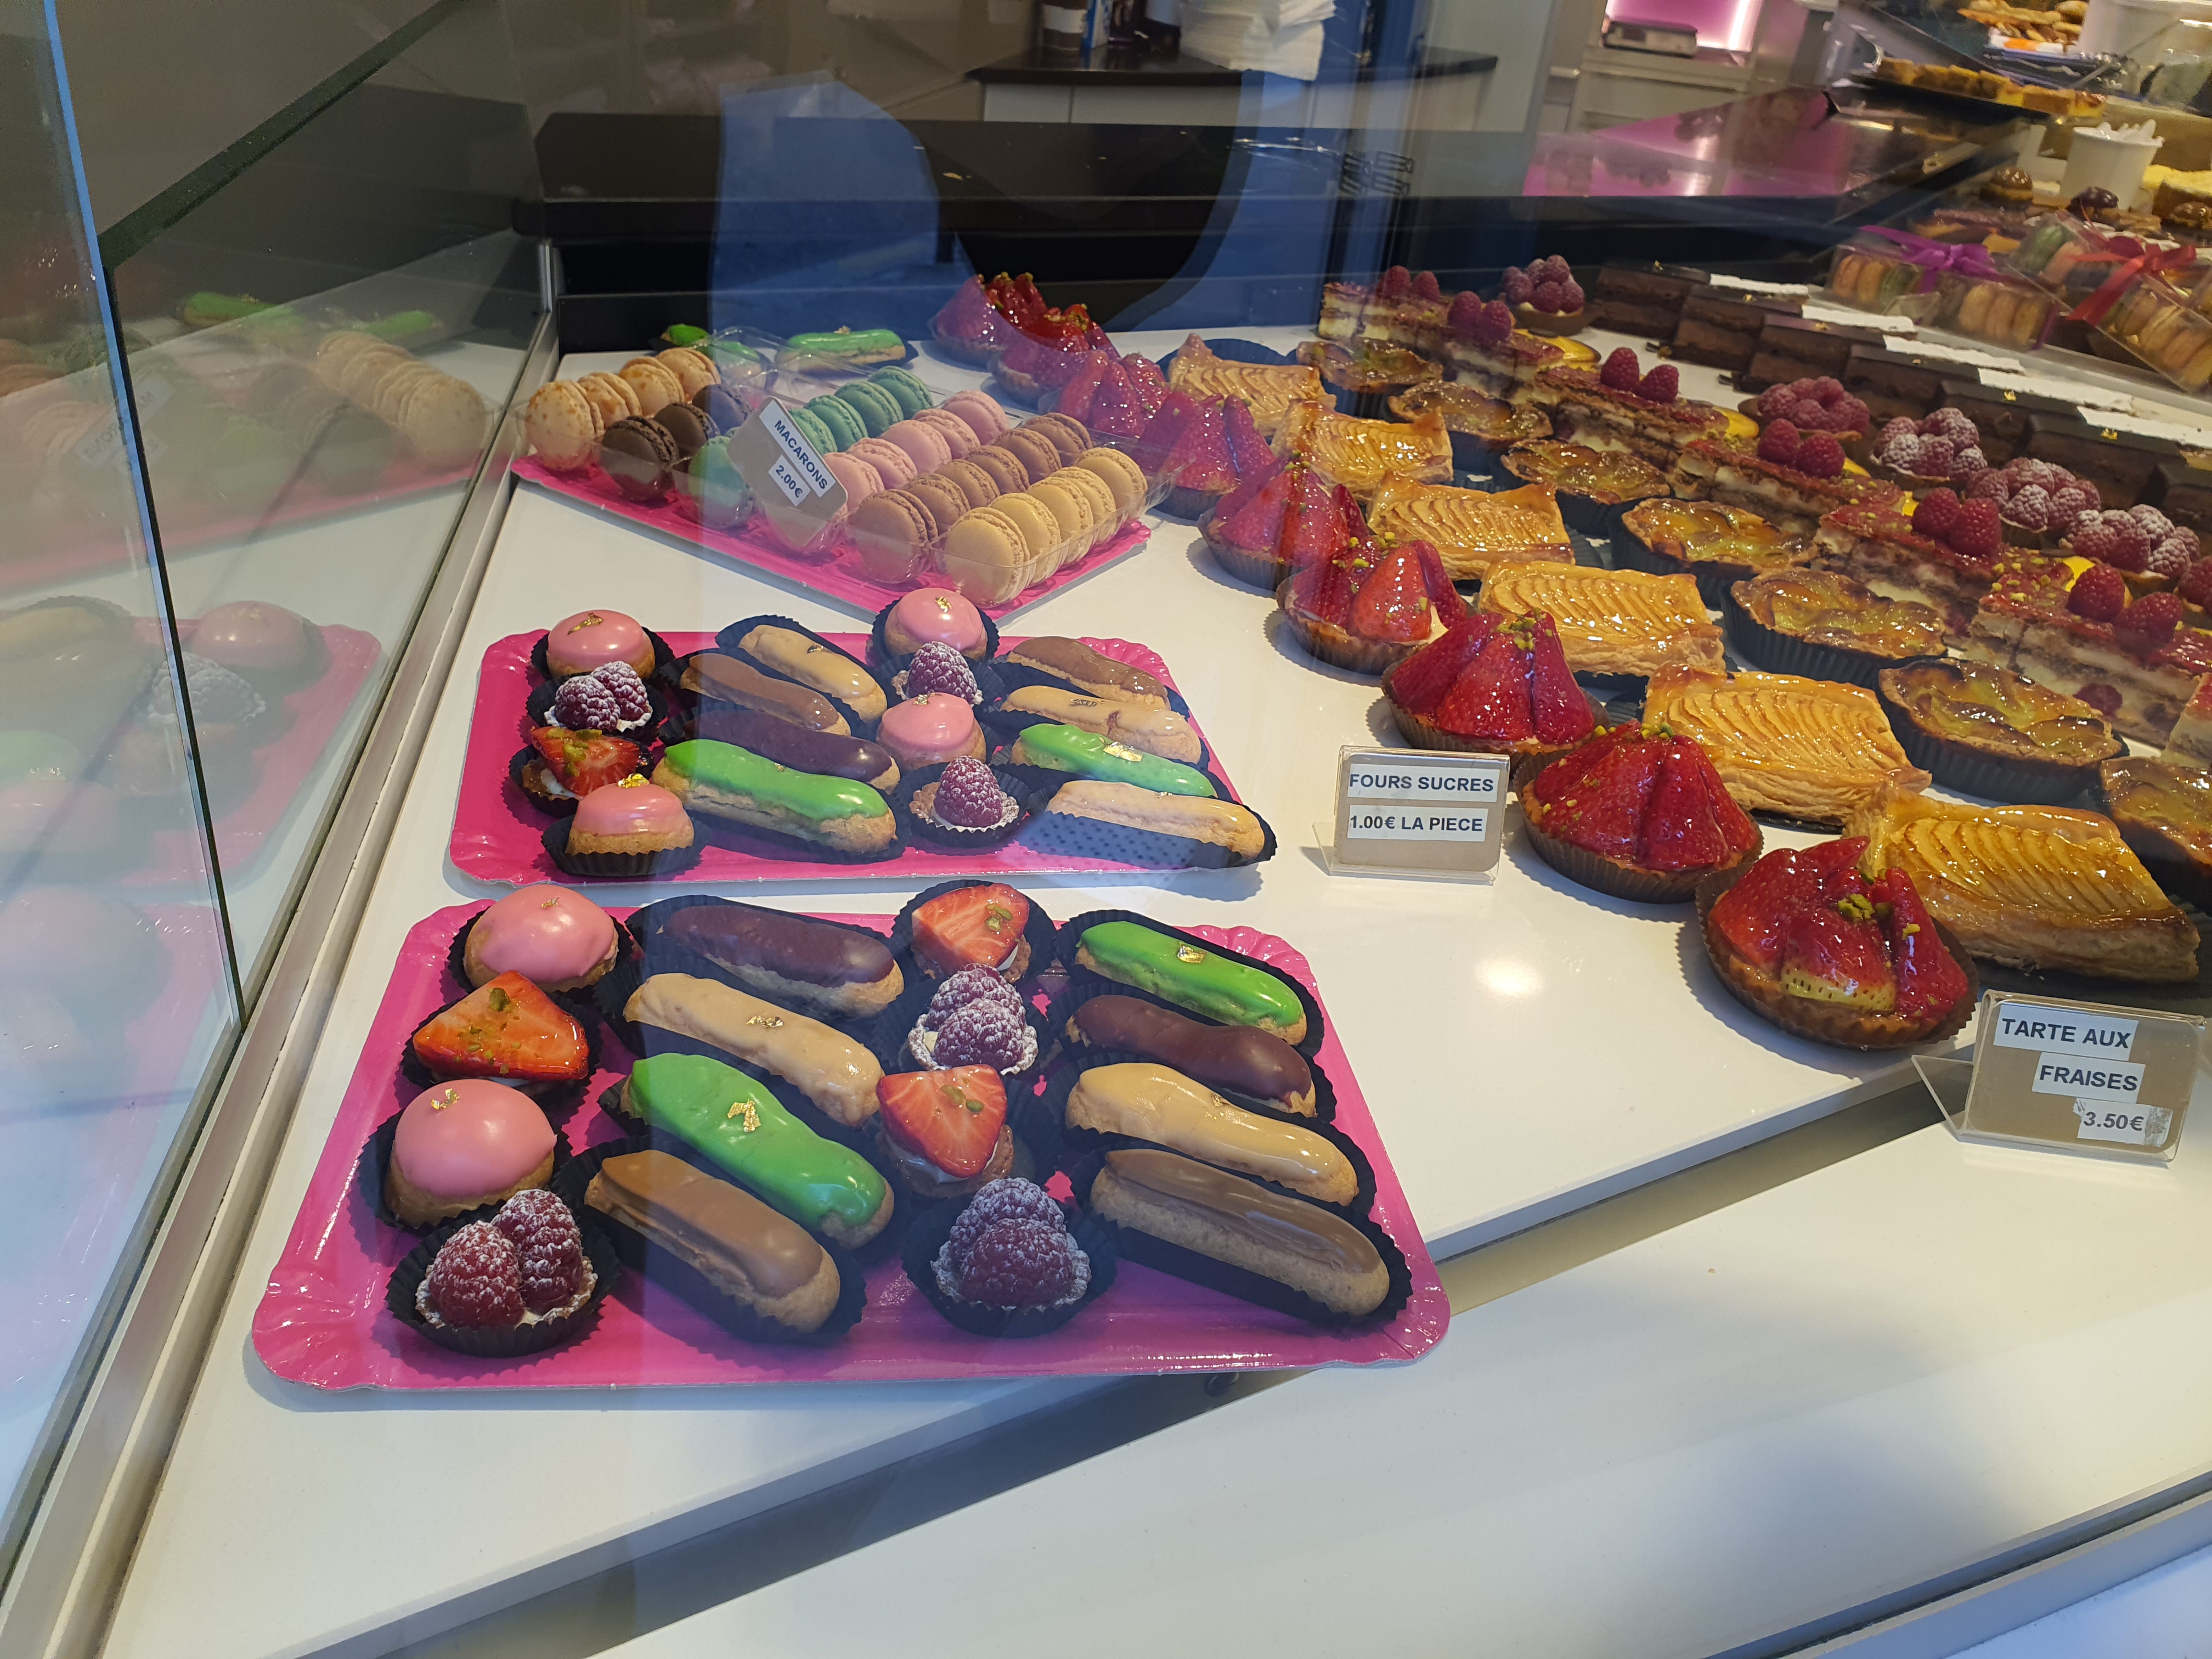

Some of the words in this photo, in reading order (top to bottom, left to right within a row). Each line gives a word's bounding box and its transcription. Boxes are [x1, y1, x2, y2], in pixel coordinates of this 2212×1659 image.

[774, 420, 828, 489] MACARONS
[775, 465, 803, 498] 2.00€
[1349, 774, 1413, 789] FOURS
[1418, 776, 1494, 792] SUCRES
[1350, 815, 1395, 830] 1.00€
[1401, 816, 1424, 830] LA
[1429, 817, 1483, 832] PIECE
[2001, 1018, 2077, 1042] TARTE
[2083, 1028, 2132, 1049] AUX
[2039, 1064, 2138, 1091] FRAISES
[2083, 1111, 2145, 1131] 3.50€
